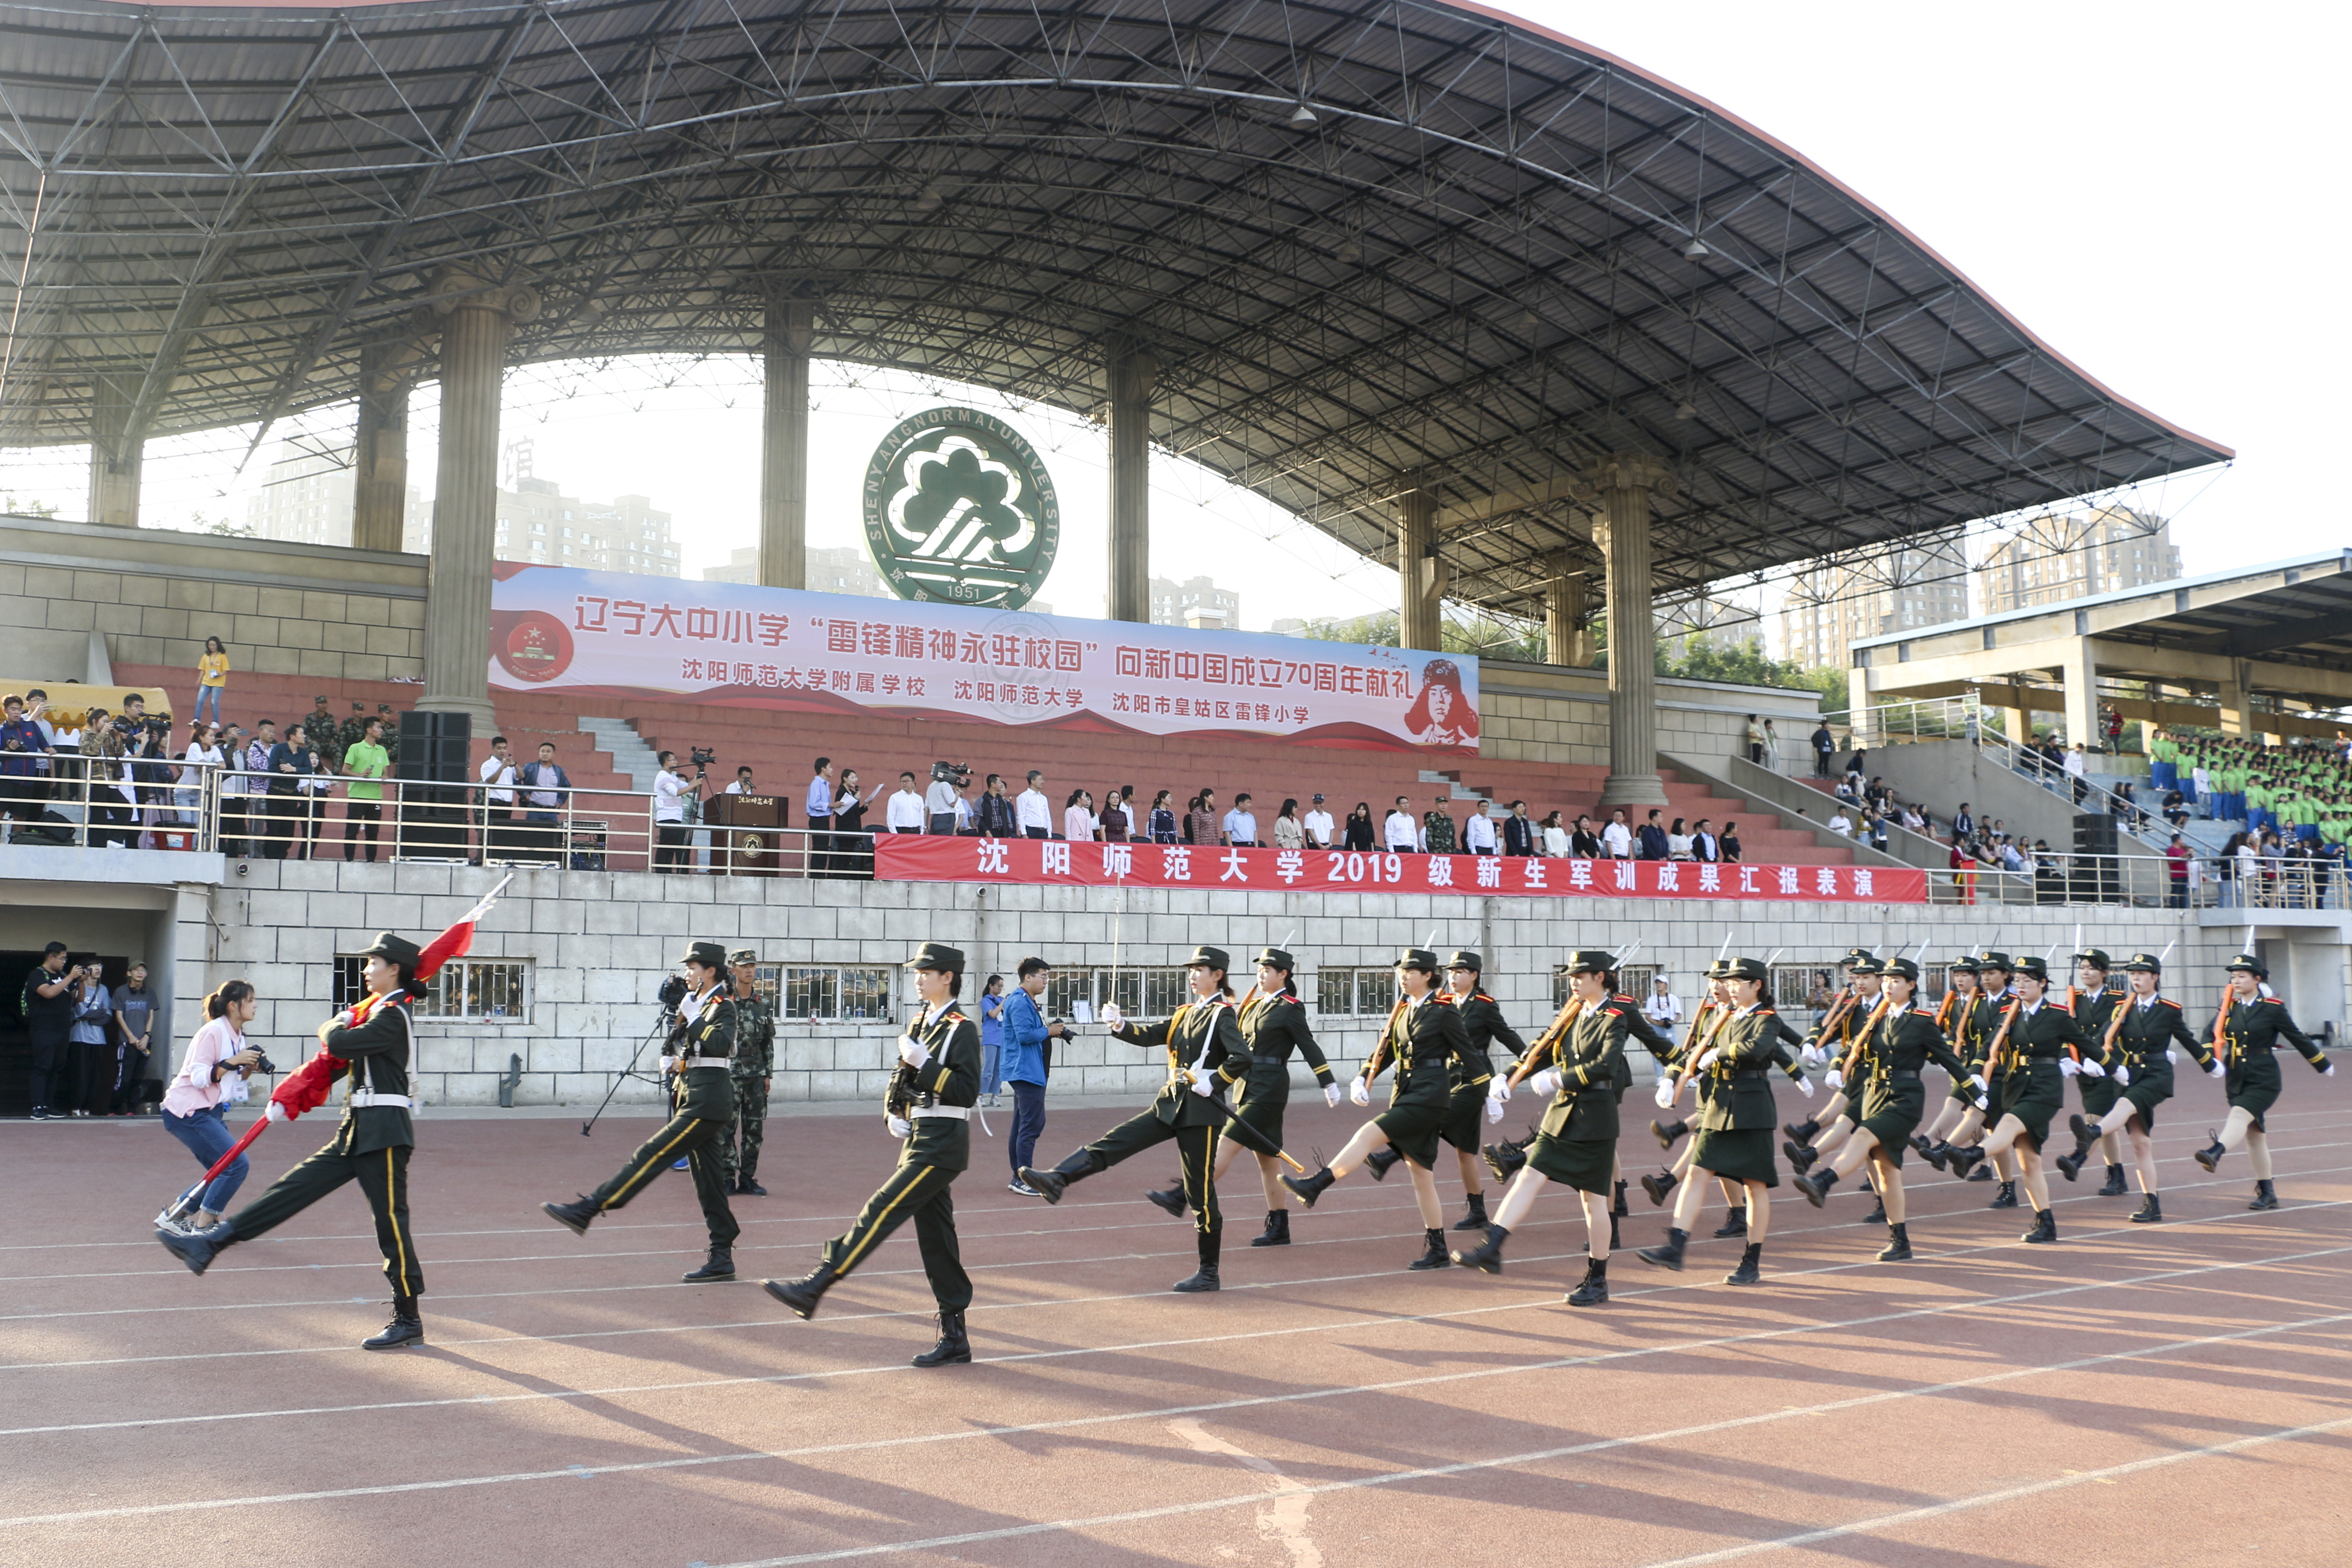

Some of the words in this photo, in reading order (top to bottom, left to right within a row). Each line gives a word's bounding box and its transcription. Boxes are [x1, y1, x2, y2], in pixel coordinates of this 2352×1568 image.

[947, 585, 980, 599] 1951
[681, 658, 927, 698] 沈阳师范大学附属学校
[953, 679, 1083, 709] 沈阳师范大学
[1112, 692, 1310, 725] 沈阳市皇姑区雷锋小学
